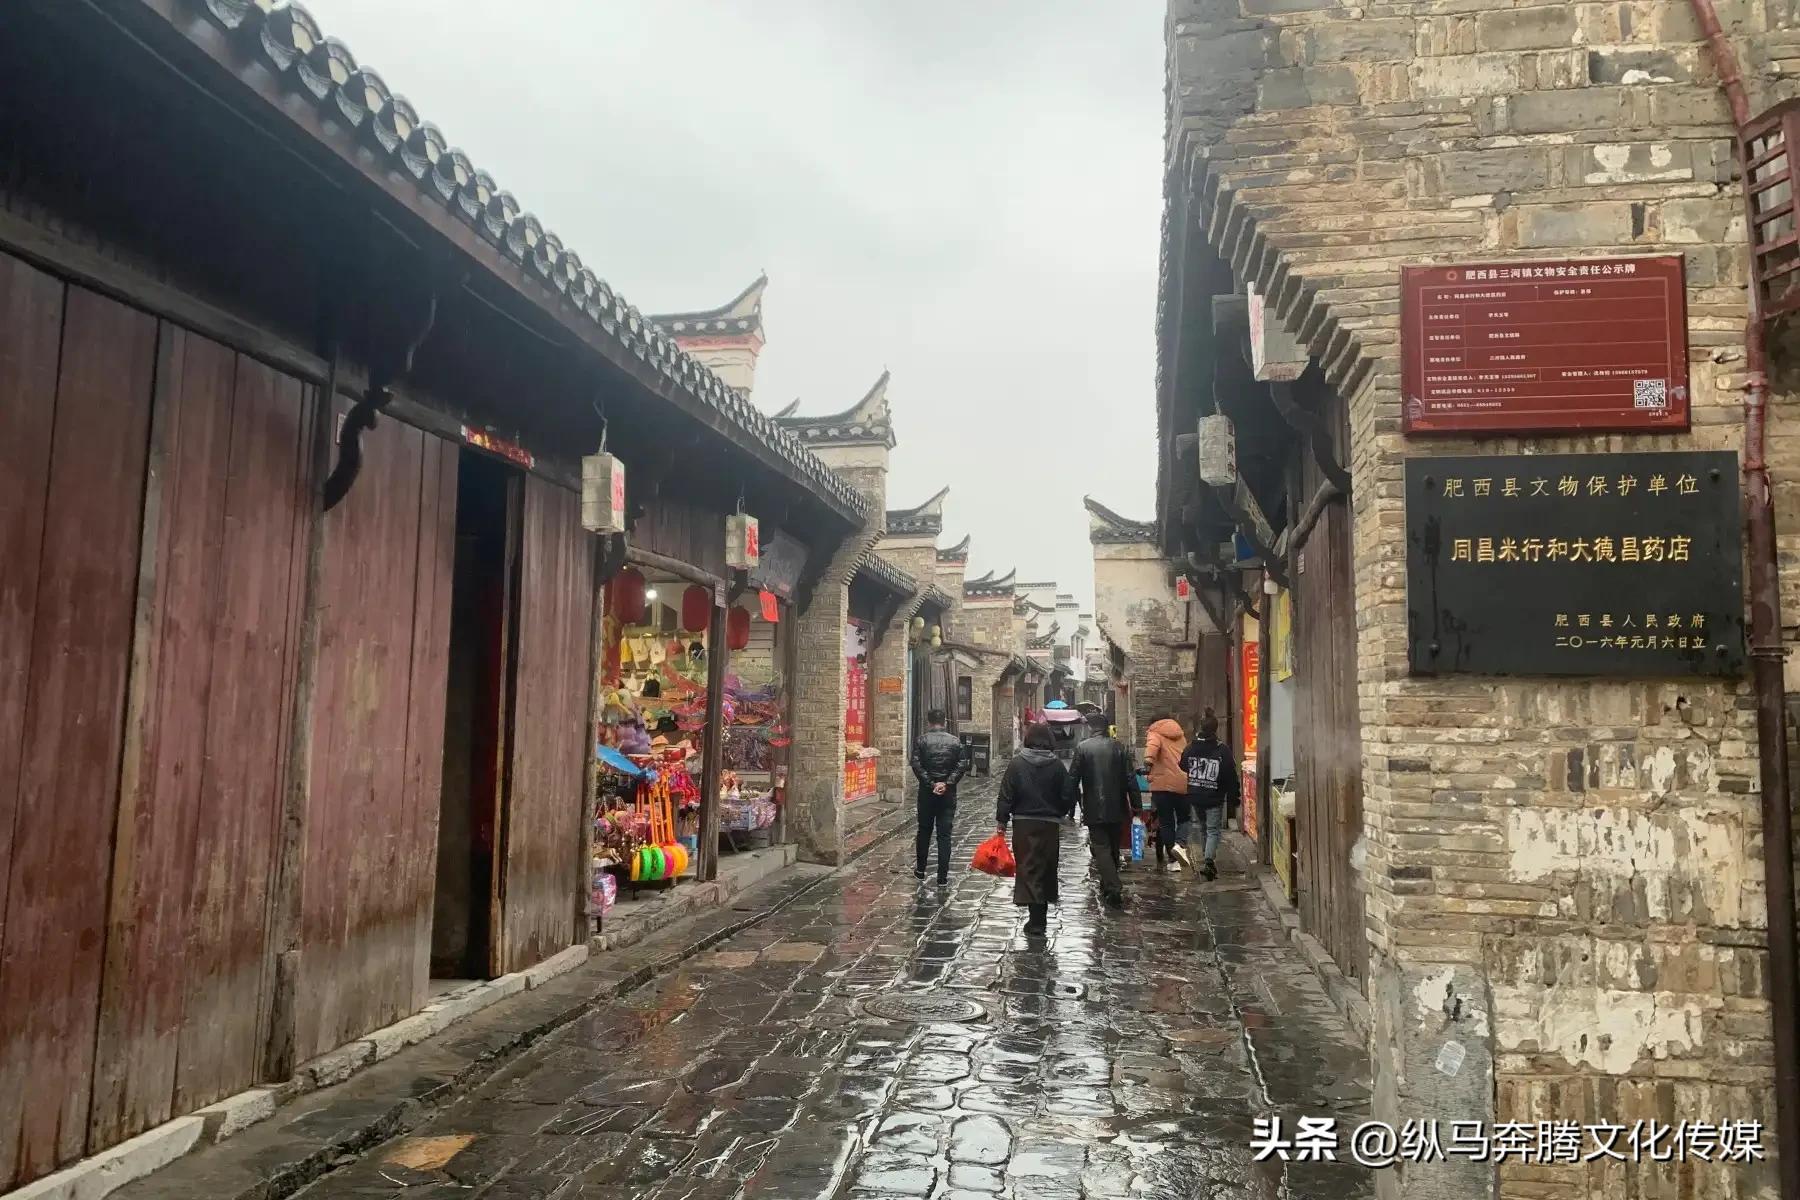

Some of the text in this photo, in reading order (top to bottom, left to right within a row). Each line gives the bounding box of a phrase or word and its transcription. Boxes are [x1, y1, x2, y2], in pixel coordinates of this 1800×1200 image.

[1465, 263, 1636, 281] 肥西县三河镇文物安全责任公示牌
[1443, 474, 1700, 498] 肥西县文物保护单位
[1450, 534, 1692, 563] 同昌米行和大德昌药店
[1554, 612, 1705, 628] 肥西县人民政府
